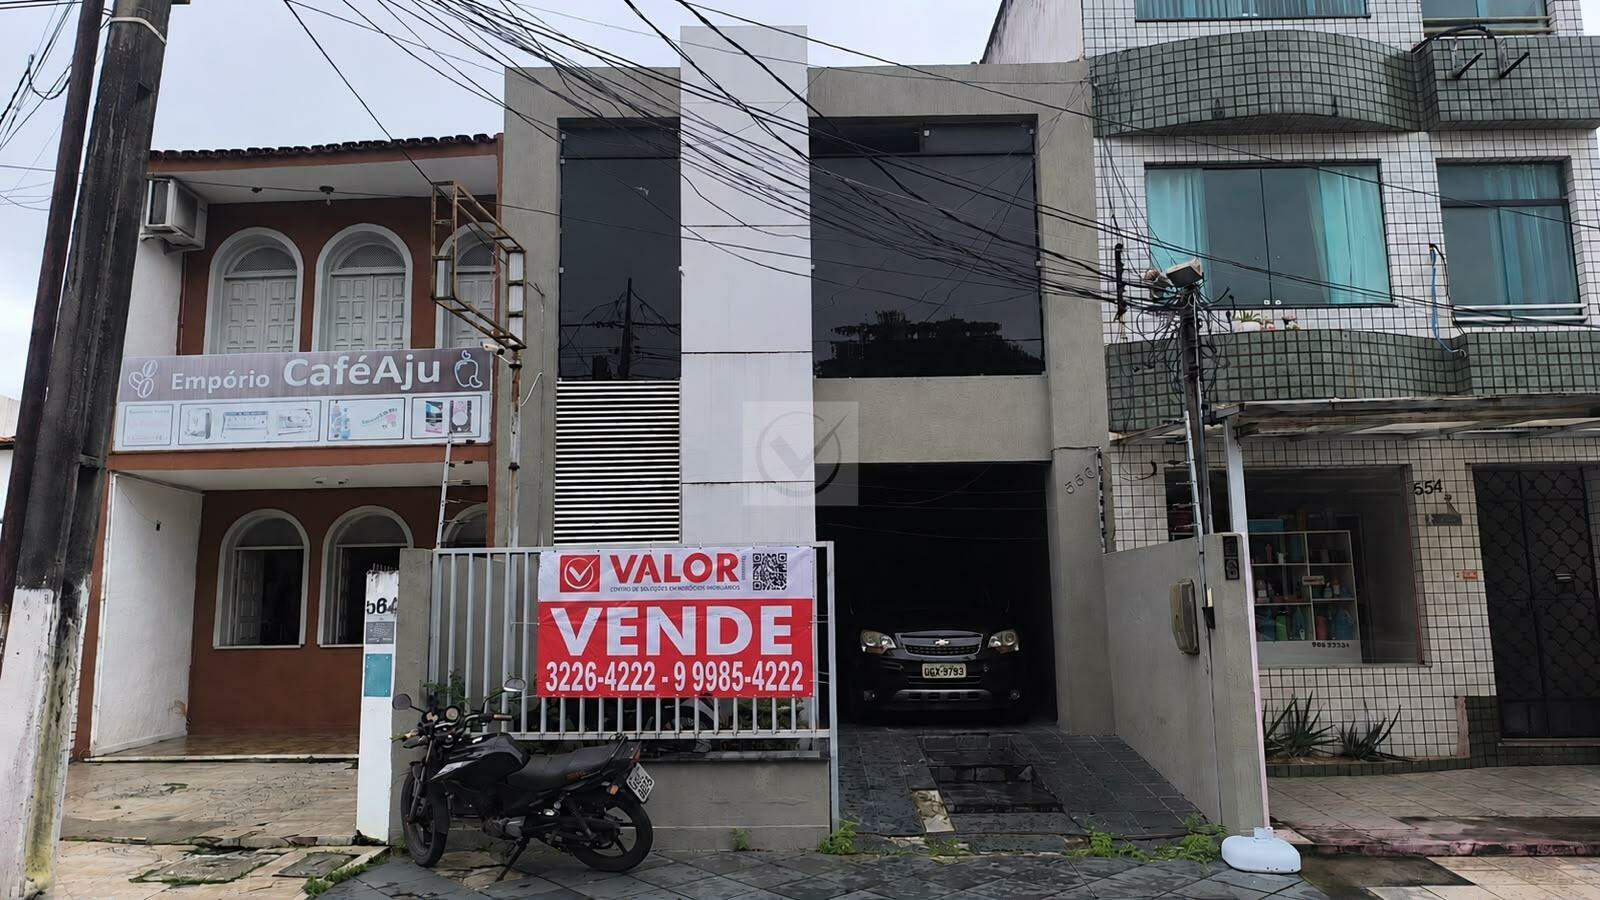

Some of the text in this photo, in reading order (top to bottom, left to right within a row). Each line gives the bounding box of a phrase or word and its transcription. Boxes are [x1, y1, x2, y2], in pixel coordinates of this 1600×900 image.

[171, 354, 440, 394] Empório CaféAju
[1413, 478, 1443, 496] 554
[609, 552, 740, 584] VALOR
[550, 605, 793, 657] VENDE
[545, 660, 656, 692] 3226-4222
[673, 661, 686, 692] 9
[691, 659, 804, 692] 9985-4222
